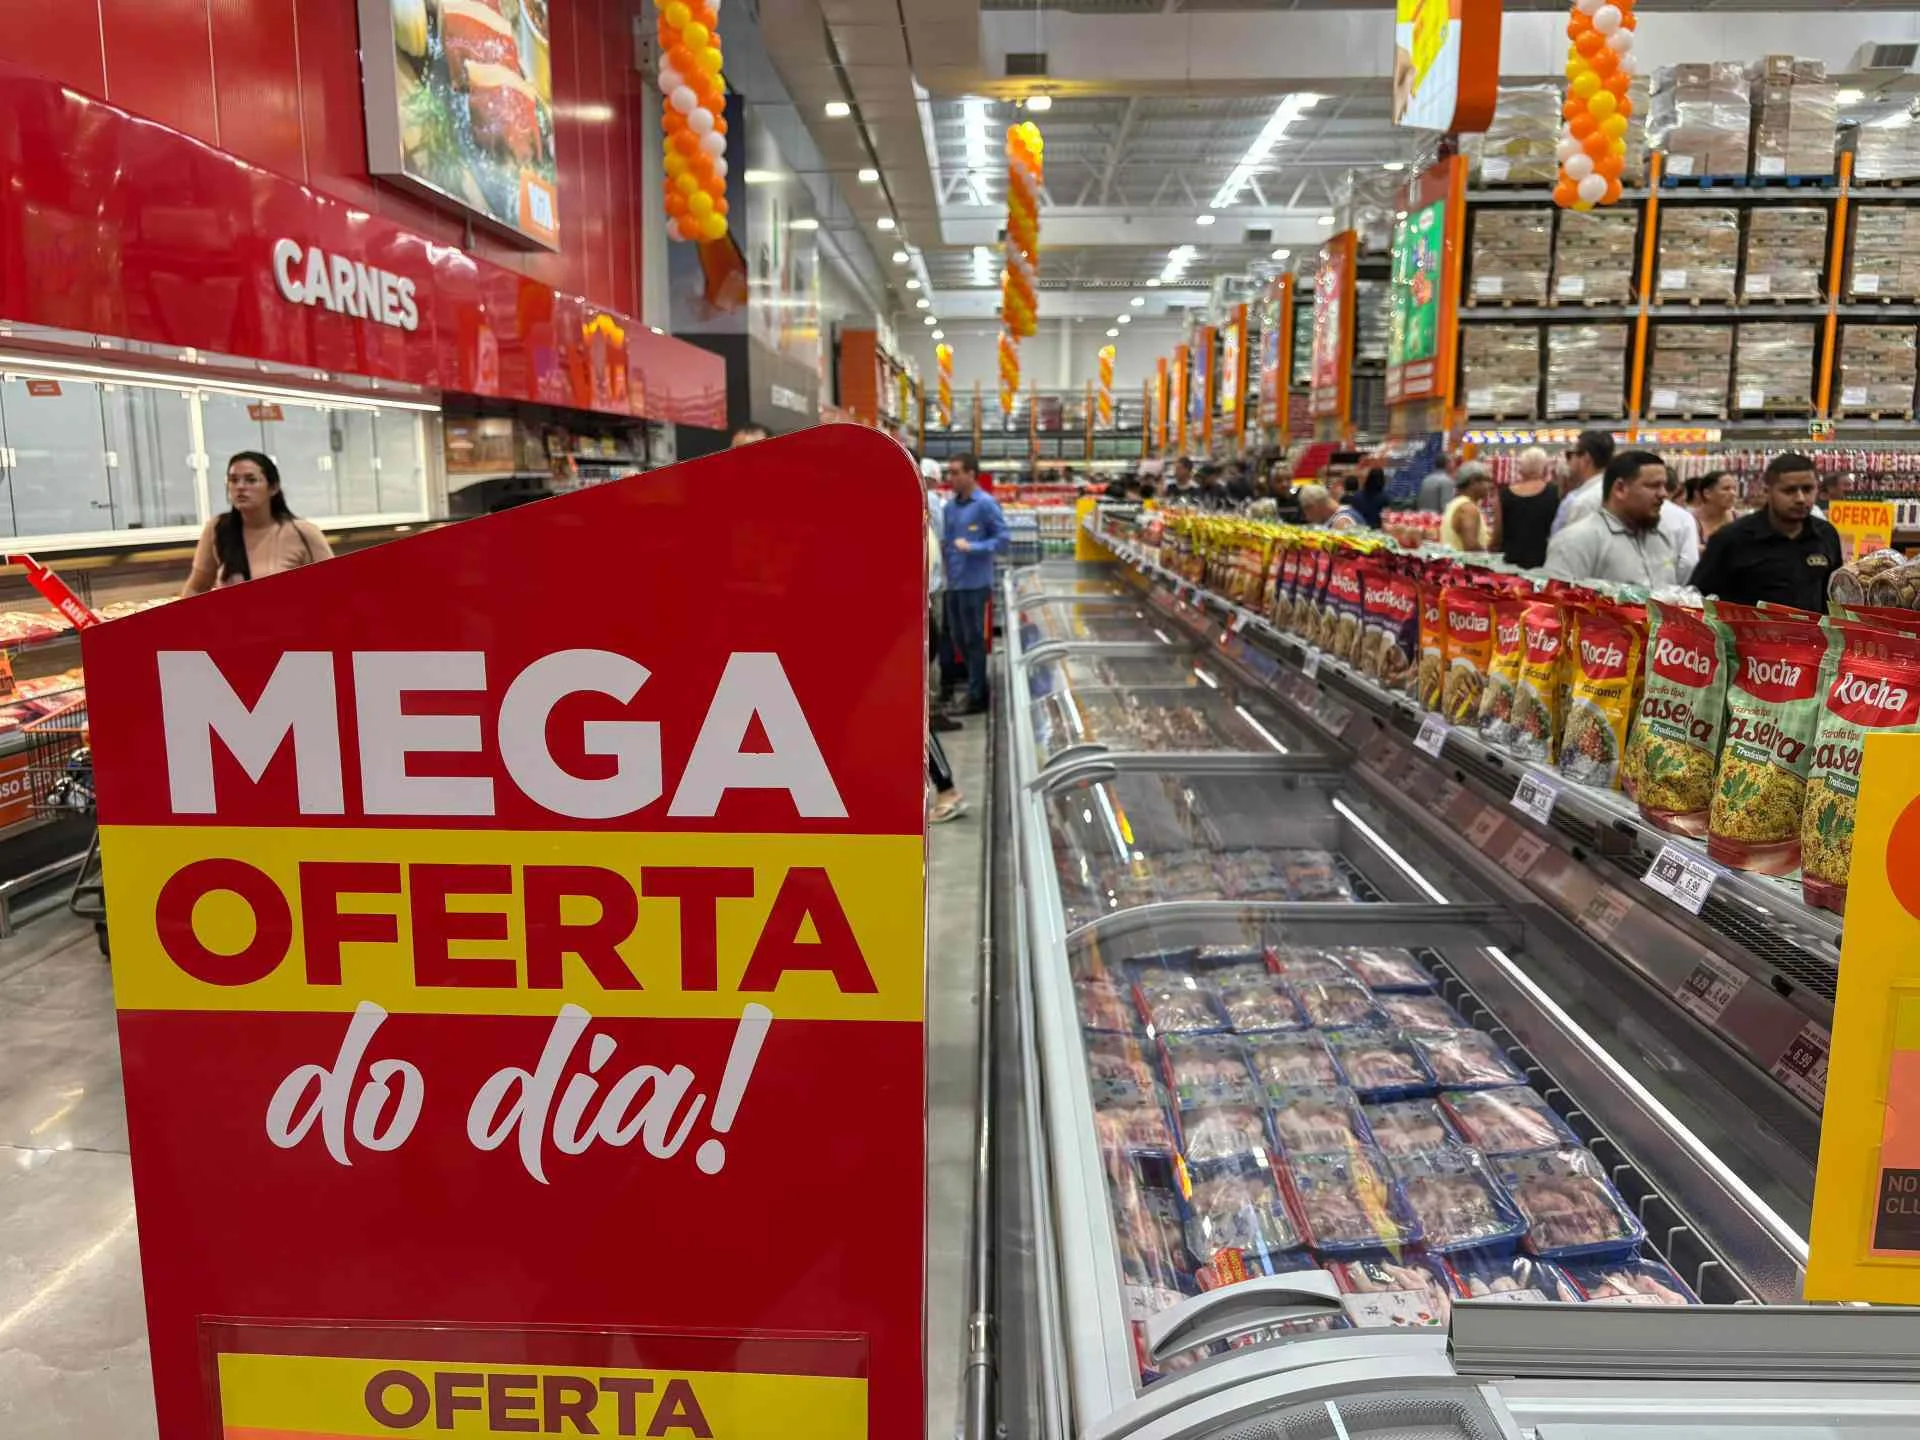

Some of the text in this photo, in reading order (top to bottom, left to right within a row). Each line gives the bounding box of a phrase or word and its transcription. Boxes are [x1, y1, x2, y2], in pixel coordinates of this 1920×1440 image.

[273, 238, 419, 331] CARNES
[1831, 505, 1889, 526] OFERTA
[1580, 639, 1623, 668] Rocha
[1653, 637, 1711, 675] Rocha
[1747, 655, 1802, 688] Rocha
[1833, 671, 1908, 712] Rocha
[156, 649, 849, 819] MEGA
[155, 857, 879, 994] OFERTA
[266, 1000, 774, 1185] do dia!
[1887, 1175, 1920, 1193] NO
[364, 1369, 714, 1439] OFERTA
